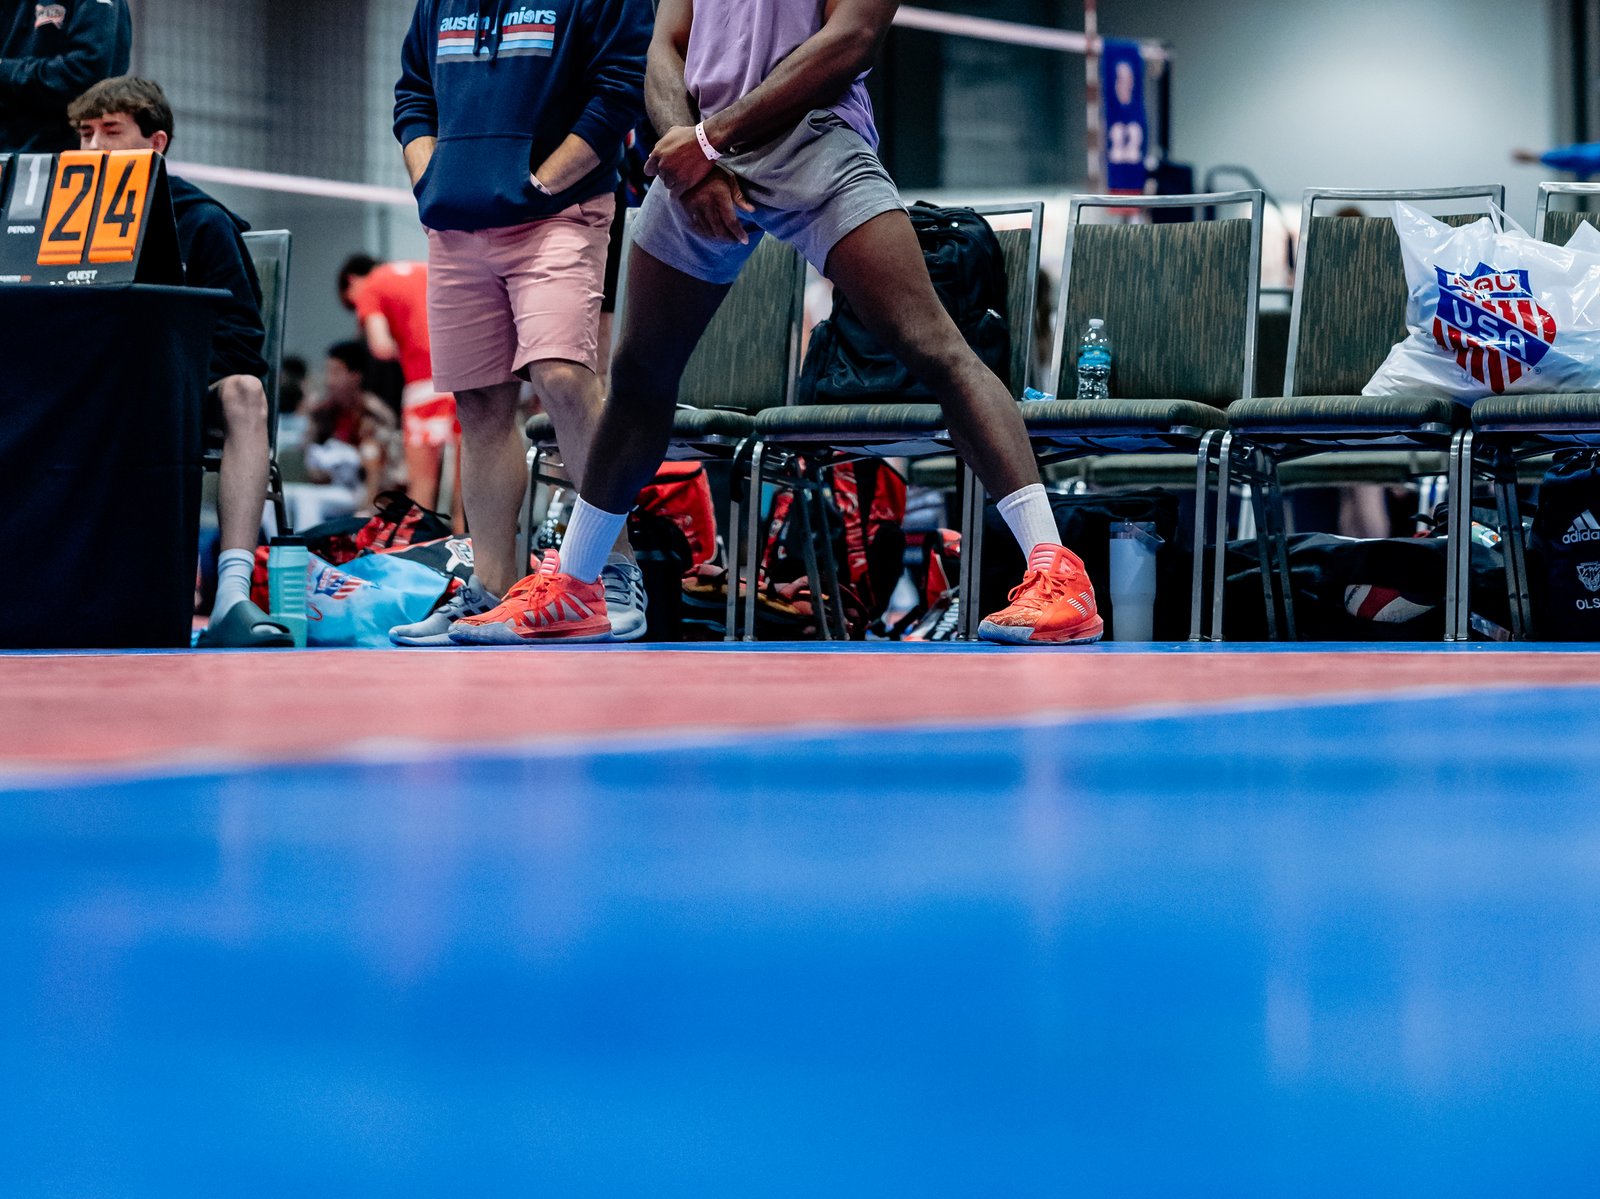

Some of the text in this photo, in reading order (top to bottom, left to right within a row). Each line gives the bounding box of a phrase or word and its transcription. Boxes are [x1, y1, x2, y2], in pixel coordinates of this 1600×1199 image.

[440, 12, 490, 32] austin
[67, 269, 98, 281] GUEST
[1452, 299, 1527, 360] USA
